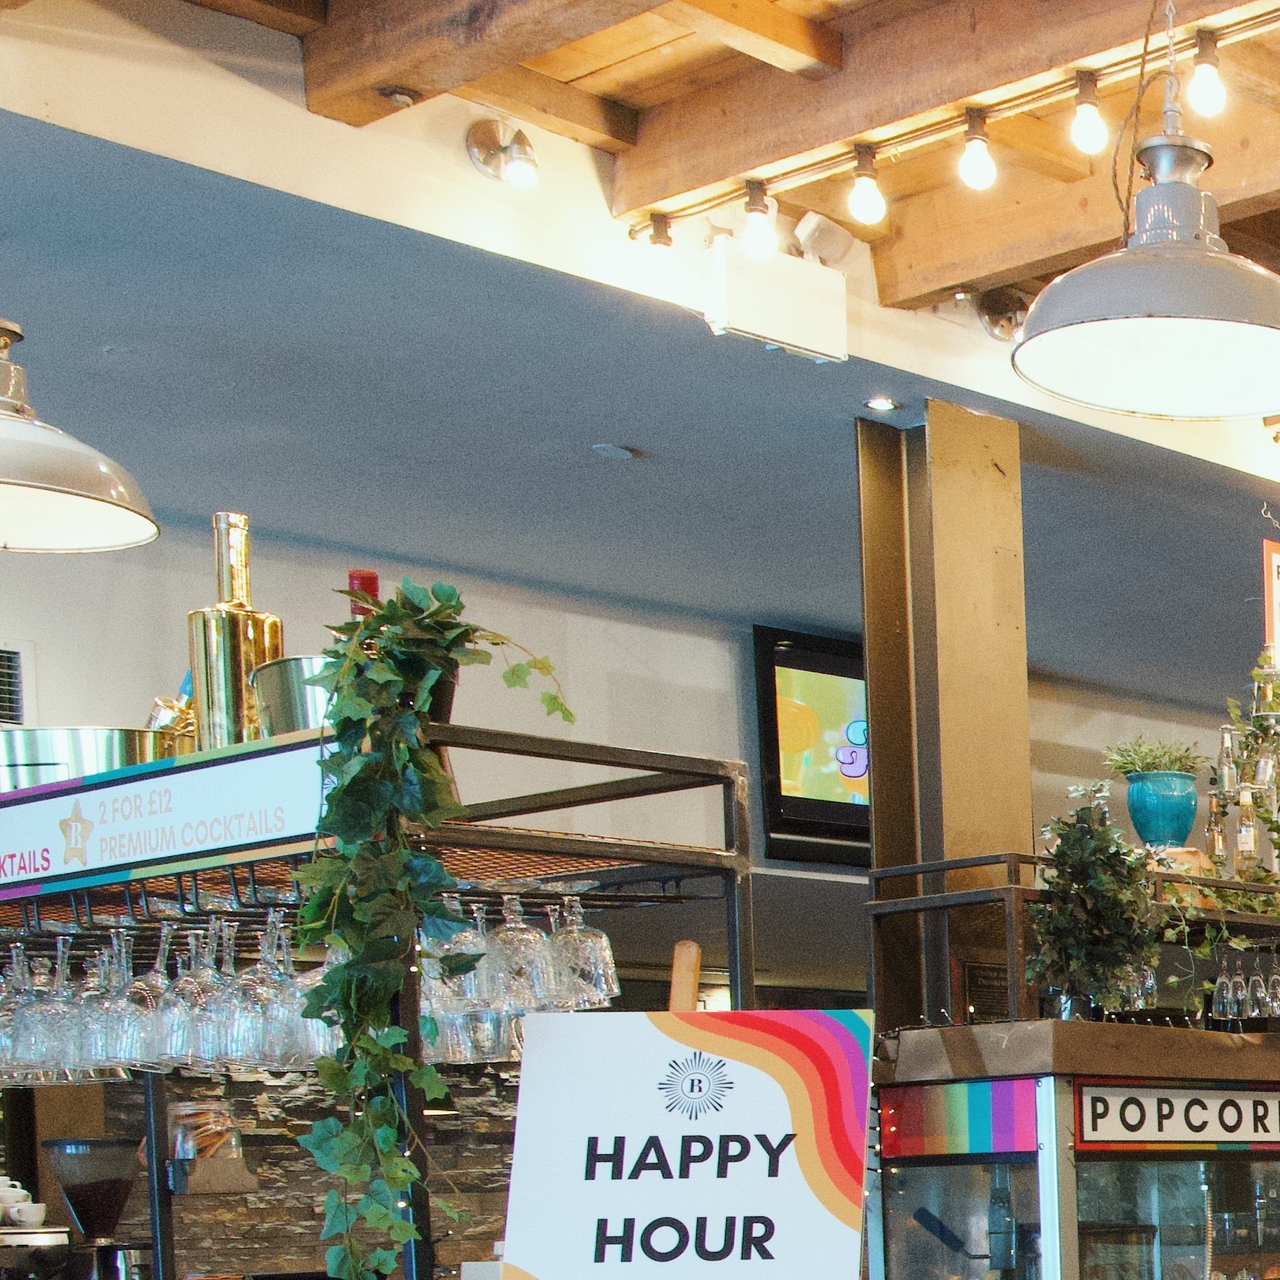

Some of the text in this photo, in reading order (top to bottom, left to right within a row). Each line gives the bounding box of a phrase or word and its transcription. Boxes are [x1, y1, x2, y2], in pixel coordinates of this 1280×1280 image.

[97, 787, 173, 825] 2 FOR £12
[98, 805, 287, 862] PREMIUM COCKTAILS
[584, 1133, 797, 1181] HAPPY
[593, 1215, 775, 1263] HOUR
